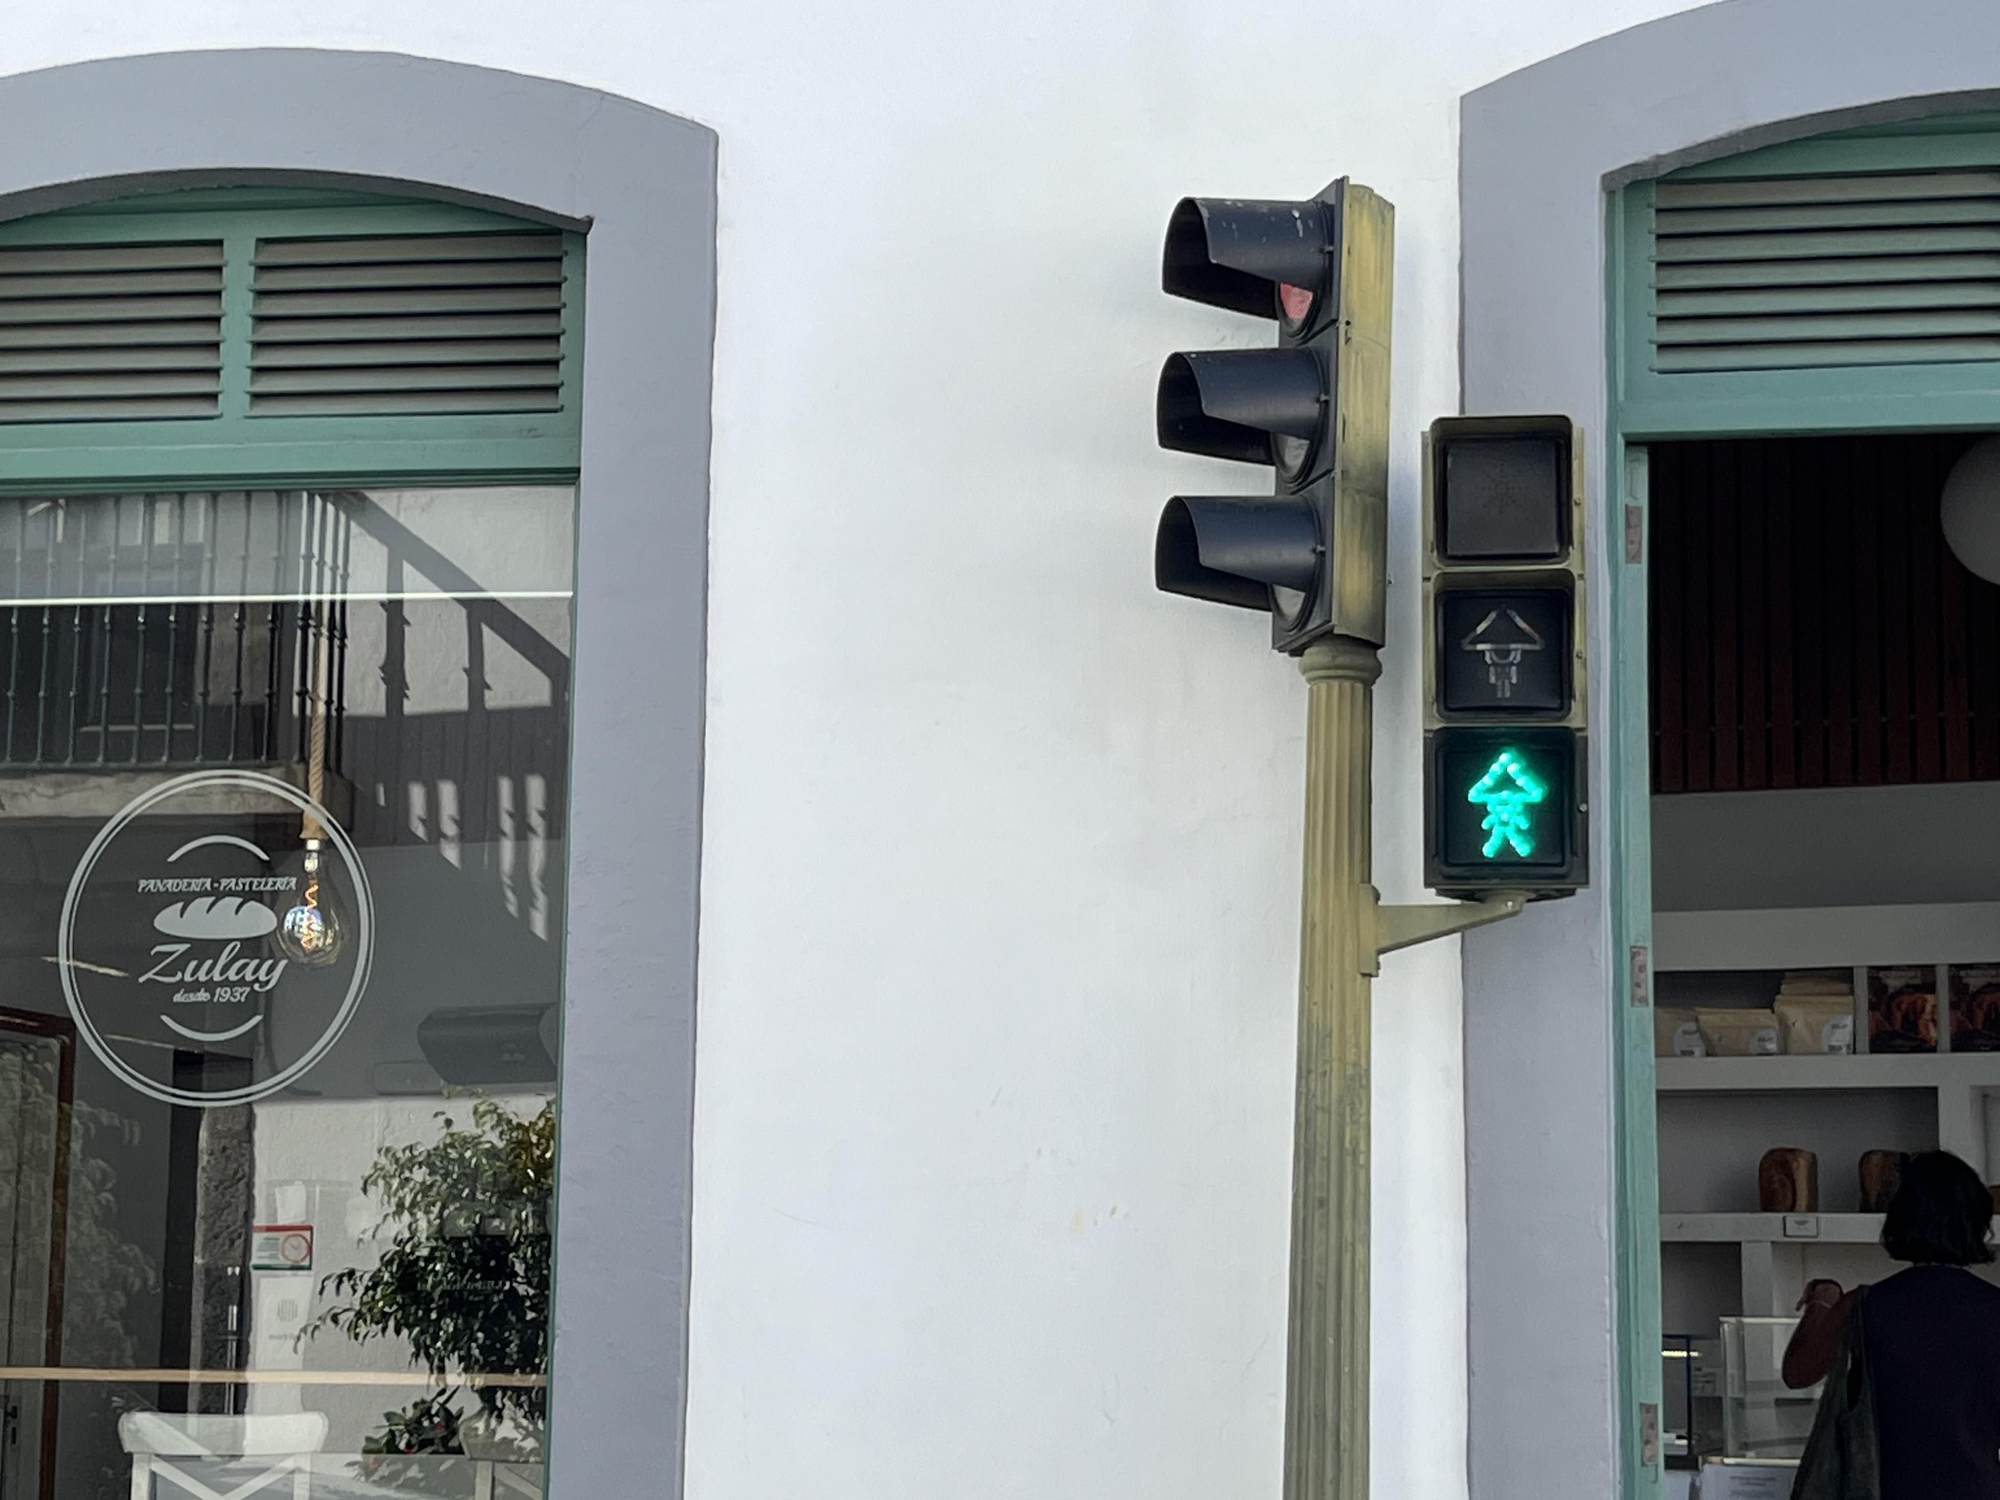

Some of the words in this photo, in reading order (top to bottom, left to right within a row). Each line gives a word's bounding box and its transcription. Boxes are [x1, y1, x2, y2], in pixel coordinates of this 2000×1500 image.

[138, 941, 289, 992] Zulay
[172, 987, 211, 1003] desde
[213, 986, 251, 1003] 1937
